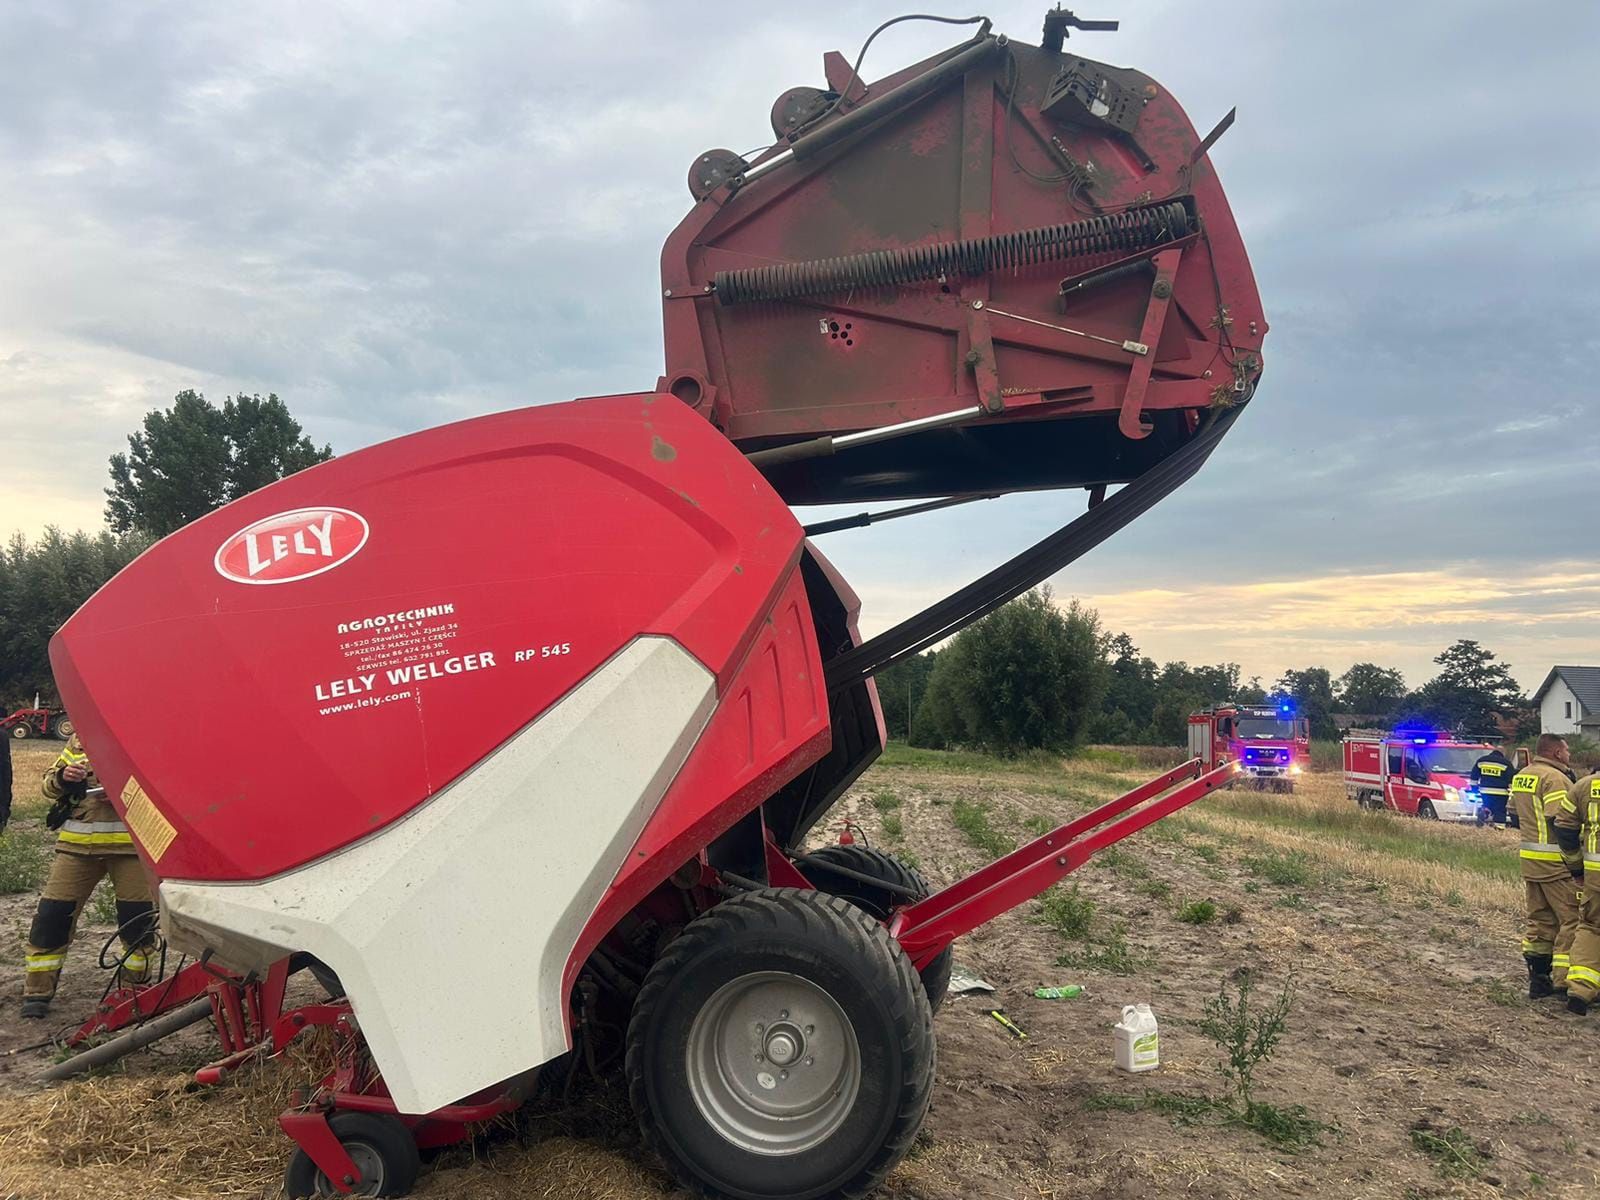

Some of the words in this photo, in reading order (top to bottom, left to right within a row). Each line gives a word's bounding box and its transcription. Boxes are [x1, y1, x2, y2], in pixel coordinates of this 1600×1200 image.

[245, 513, 334, 577] LELY
[337, 603, 455, 634] AGROTECHNIK
[339, 639, 370, 650] 18-520
[371, 631, 409, 644] Stawiski,
[423, 624, 446, 635] Zjazd
[447, 622, 459, 630] 34
[387, 638, 421, 649] MASZYN
[515, 649, 535, 662] RP
[541, 643, 570, 657] 545
[314, 673, 377, 701] LELY
[385, 651, 497, 686] WELGER
[356, 661, 388, 672] SERWIS
[319, 690, 411, 716] www.lely.com
